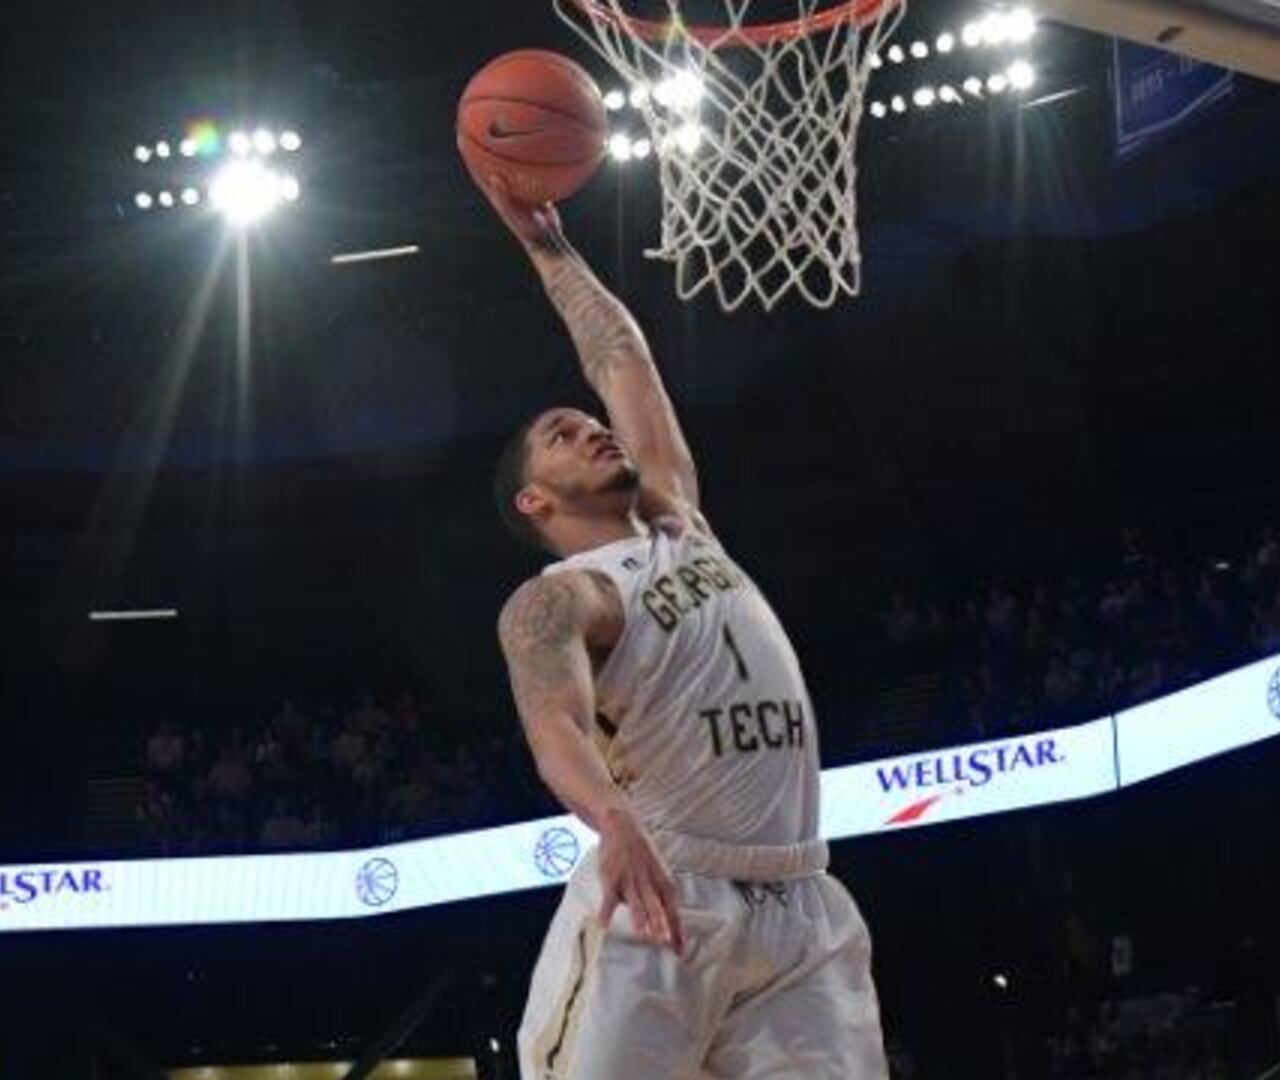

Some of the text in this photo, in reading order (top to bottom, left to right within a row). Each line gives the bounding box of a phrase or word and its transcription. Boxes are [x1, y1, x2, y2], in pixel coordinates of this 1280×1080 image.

[722, 621, 751, 682] 1
[698, 700, 806, 757] TECH
[876, 738, 1058, 792] WELLSTAR
